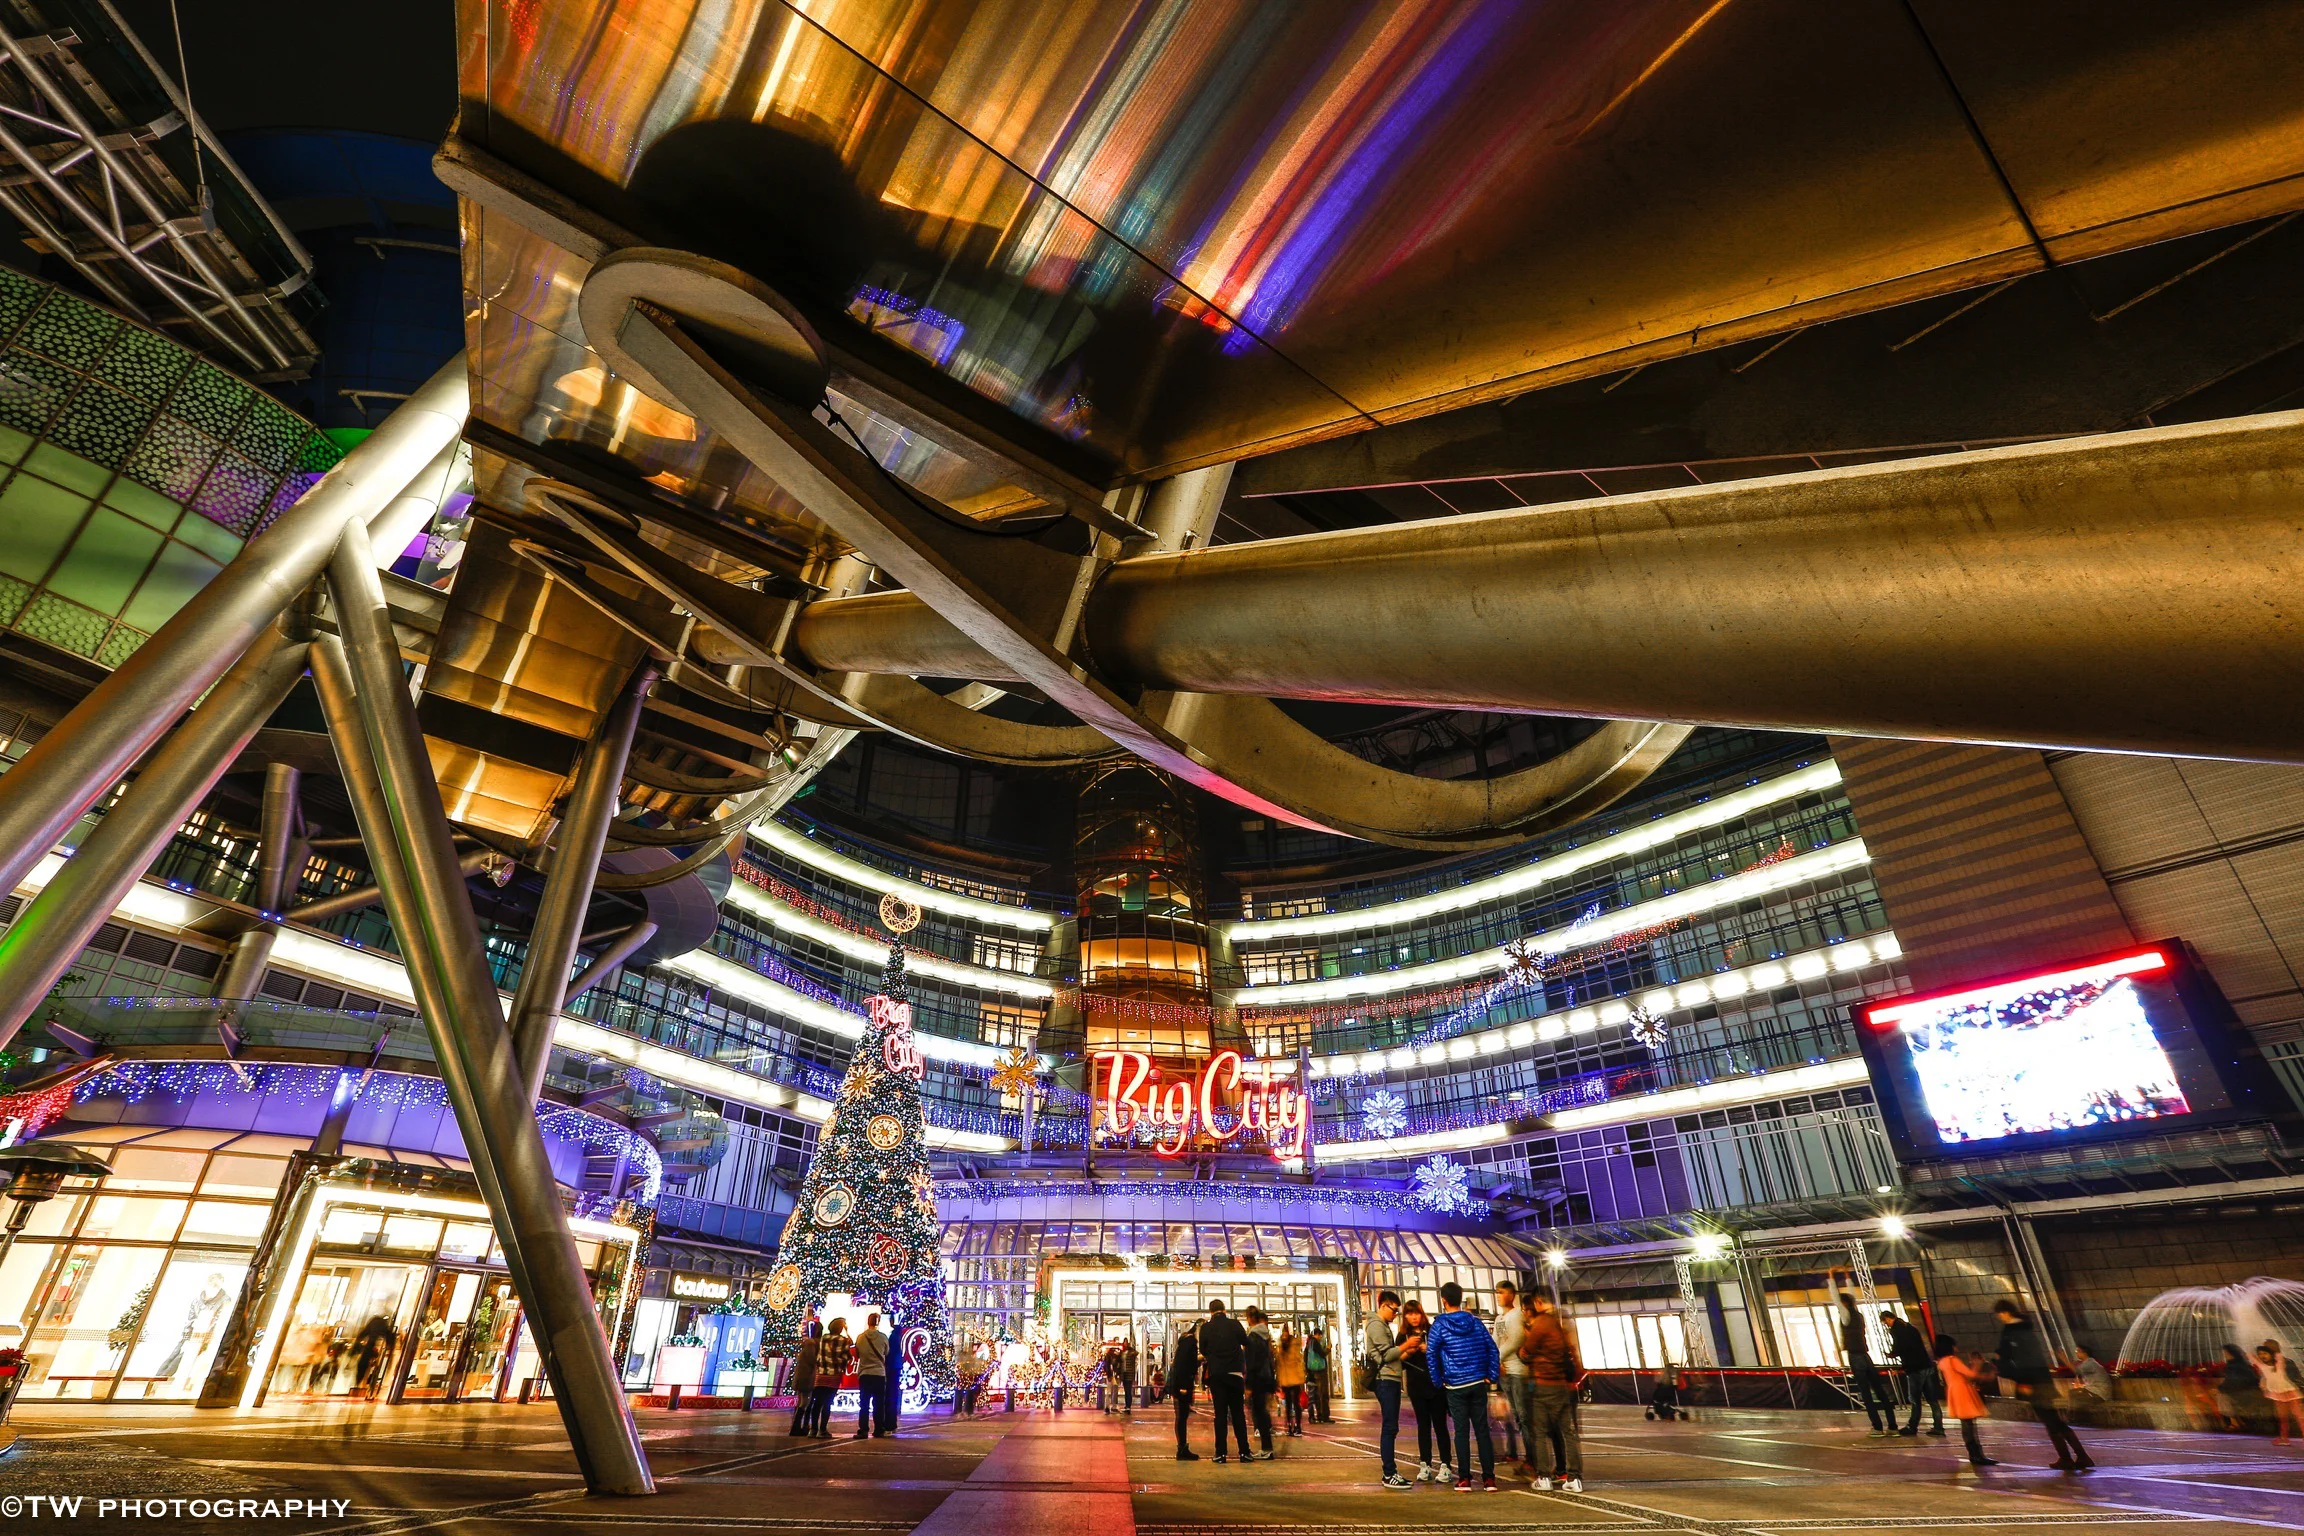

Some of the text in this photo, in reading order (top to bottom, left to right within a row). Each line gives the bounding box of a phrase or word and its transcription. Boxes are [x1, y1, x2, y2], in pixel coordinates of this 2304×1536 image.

[862, 994, 911, 1034] Big
[884, 1033, 925, 1079] City
[1093, 1050, 1308, 1160] Big City
[673, 1274, 729, 1300] bauhaus
[704, 1326, 719, 1353] AP
[725, 1326, 757, 1354] GAP
